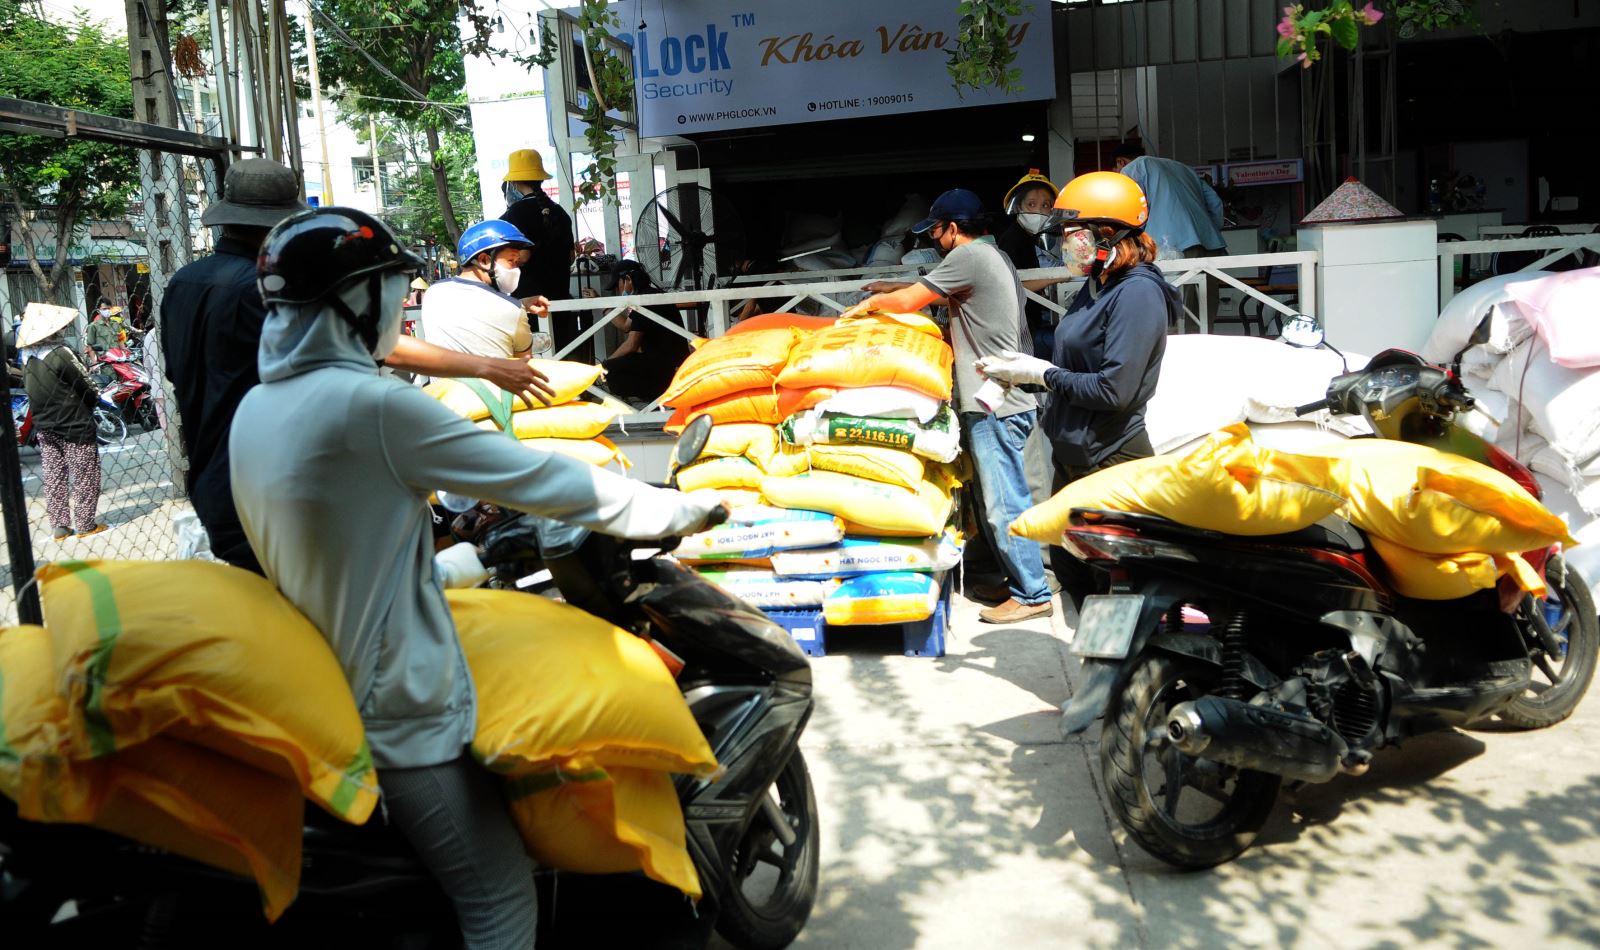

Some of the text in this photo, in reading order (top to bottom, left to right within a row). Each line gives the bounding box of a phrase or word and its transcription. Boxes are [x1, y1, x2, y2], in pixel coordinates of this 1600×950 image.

[732, 13, 755, 28] TM
[758, 24, 949, 66] Khóa Vân
[643, 78, 733, 100] Security
[819, 99, 861, 111] HOTLINE
[867, 93, 914, 106] 19009015
[689, 107, 777, 123] WWW.PHGLOCK.VN
[849, 428, 909, 445] 22.116.116
